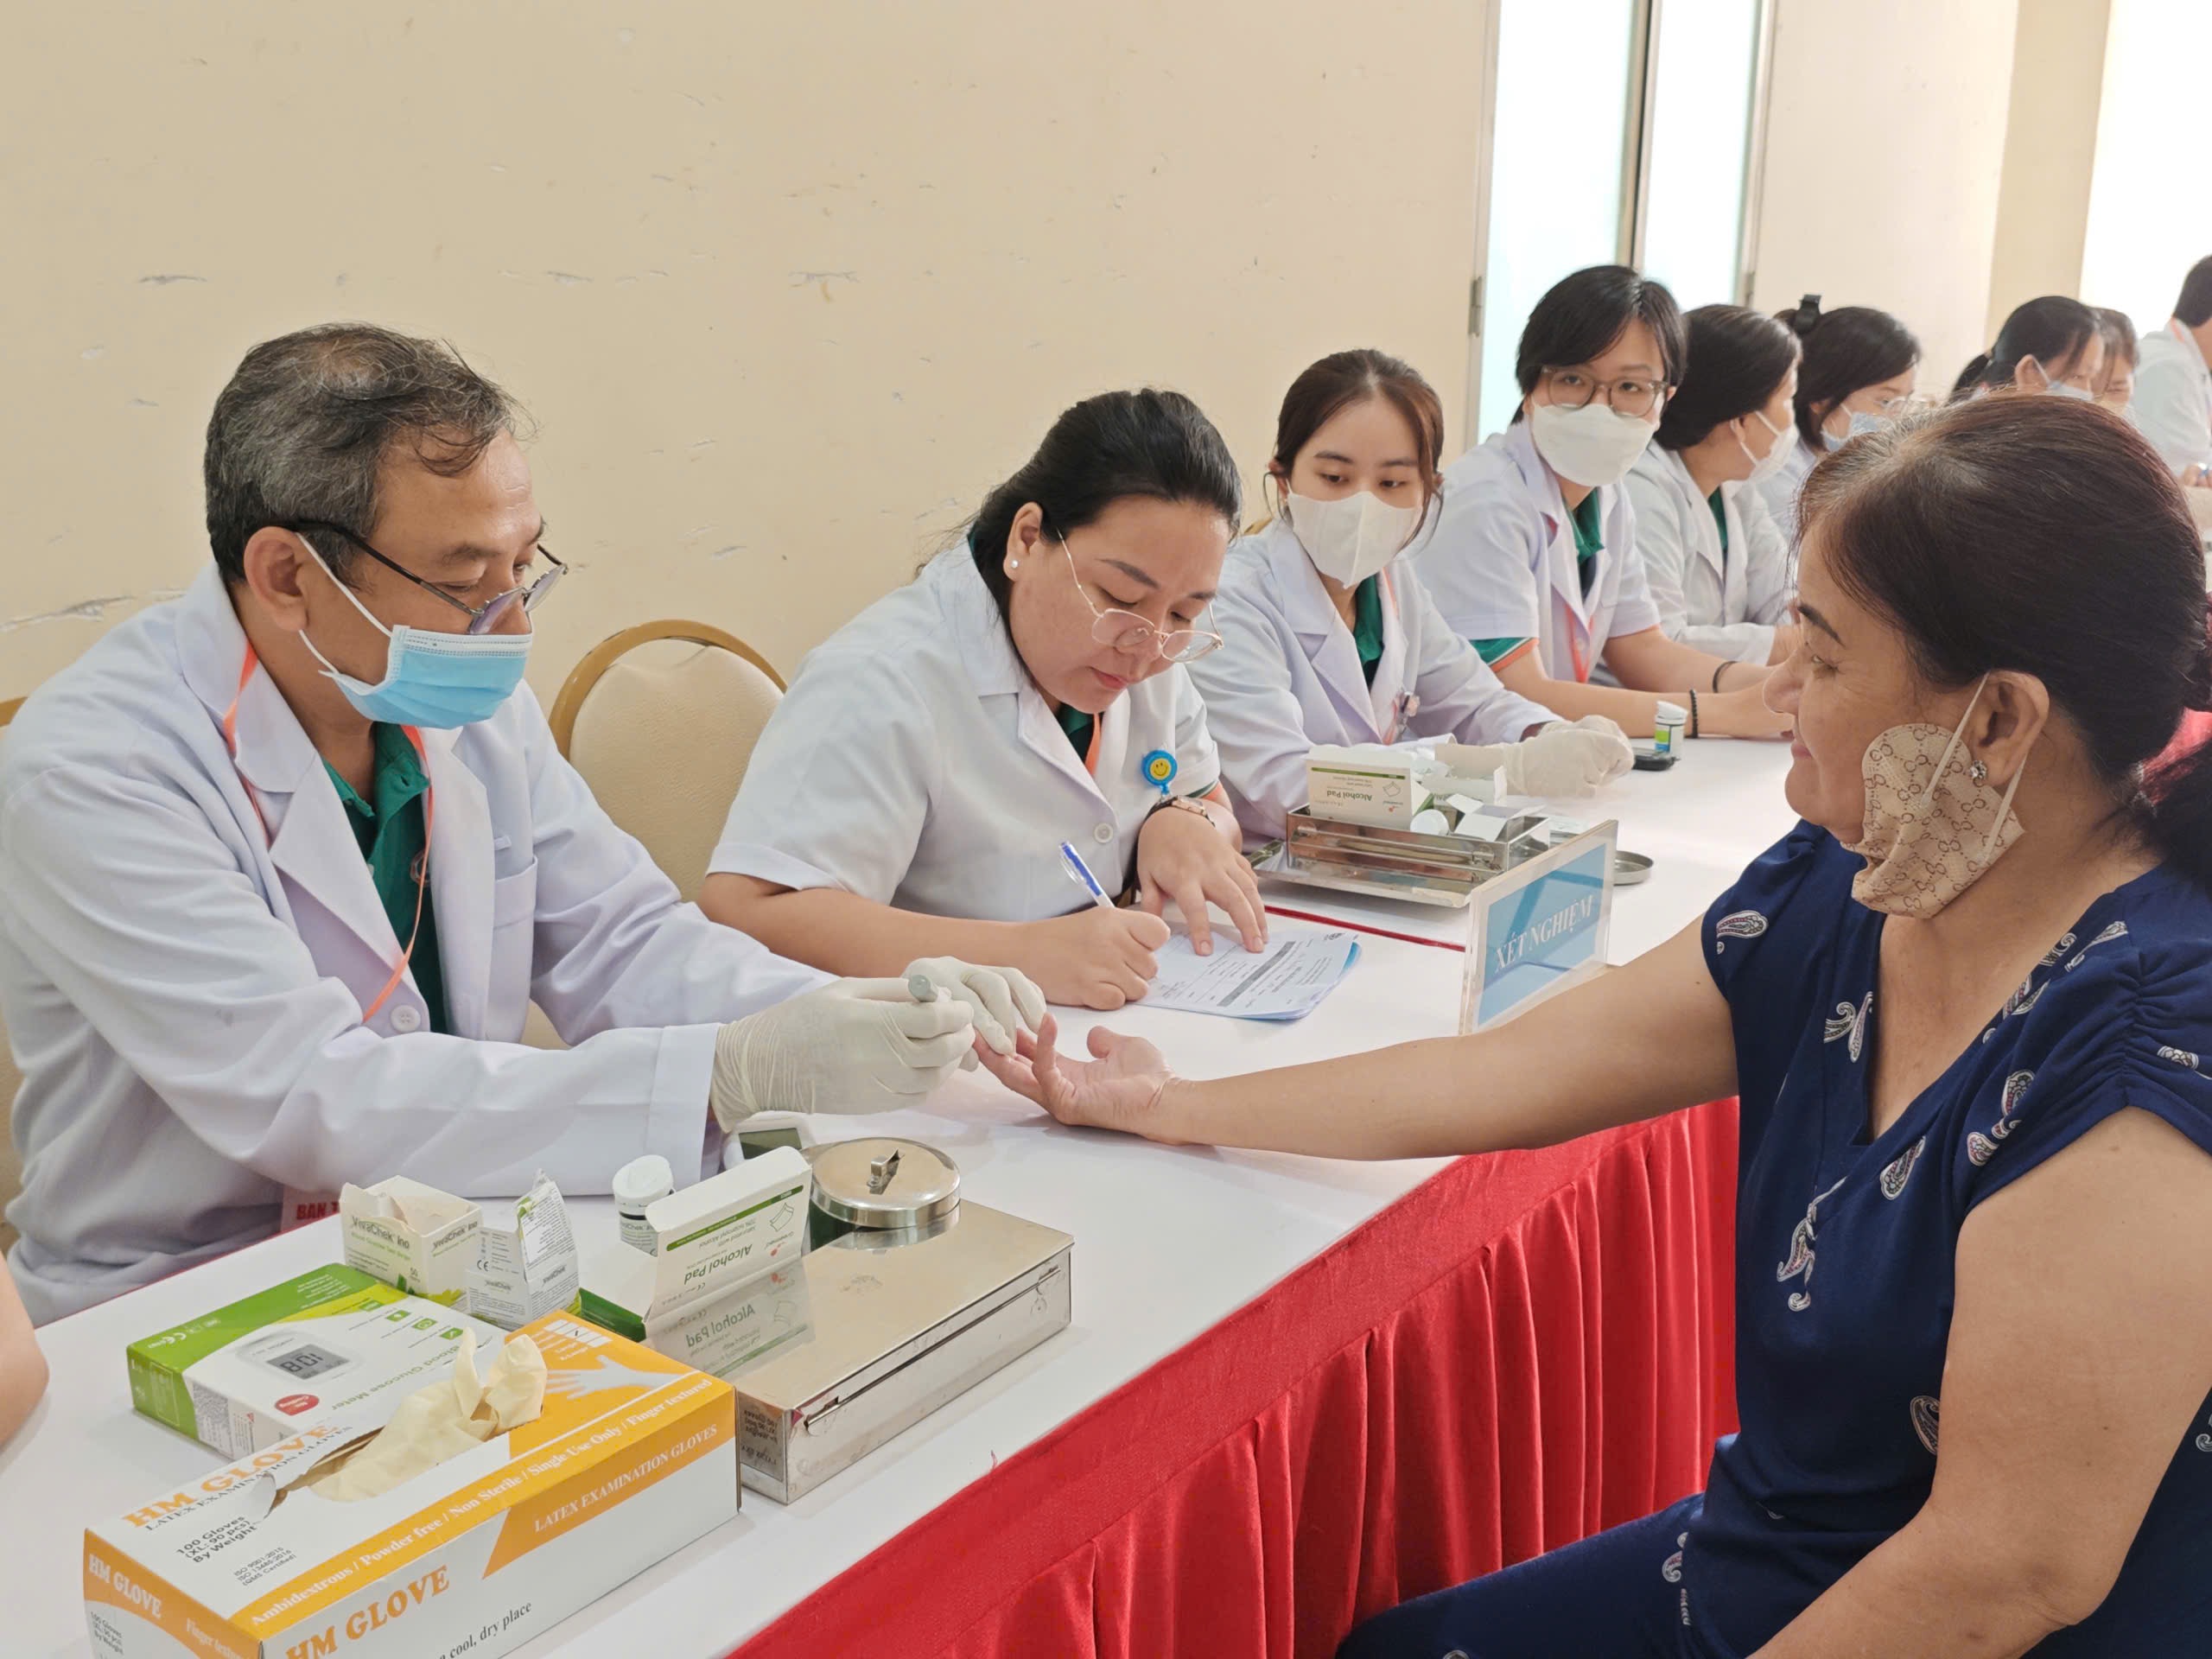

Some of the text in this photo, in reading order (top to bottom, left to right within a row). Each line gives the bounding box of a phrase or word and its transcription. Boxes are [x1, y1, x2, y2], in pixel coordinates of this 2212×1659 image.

[1326, 789, 1372, 801] Alcohol Pad
[296, 1202, 327, 1220] BAN
[683, 1264, 706, 1285] Pad
[709, 1243, 753, 1274] Alcohol
[121, 1492, 198, 1528] HM
[200, 1425, 340, 1492] GLOVE
[534, 1501, 578, 1533] LATEX
[580, 1452, 669, 1509] EXAMINATION
[670, 1425, 718, 1458] GLOVES
[145, 1507, 196, 1531] LATEX
[251, 1567, 353, 1625] Ambidextrous
[359, 1533, 414, 1567] Powder
[413, 1518, 443, 1539] free
[448, 1499, 481, 1518] Non
[480, 1475, 523, 1503] Sterile
[528, 1453, 569, 1478] Single
[566, 1440, 594, 1457] Use
[590, 1426, 624, 1446] Only
[626, 1403, 666, 1427] Finger
[664, 1378, 714, 1407] textured
[175, 1516, 245, 1554] 100 Gloves
[193, 1525, 257, 1562] By Weight
[209, 1534, 225, 1544] 90
[226, 1520, 251, 1536] pcs)
[88, 1553, 162, 1619] HM GLOVE
[284, 1565, 450, 1659] HM GLOVE
[449, 1601, 532, 1659] cool, dry place
